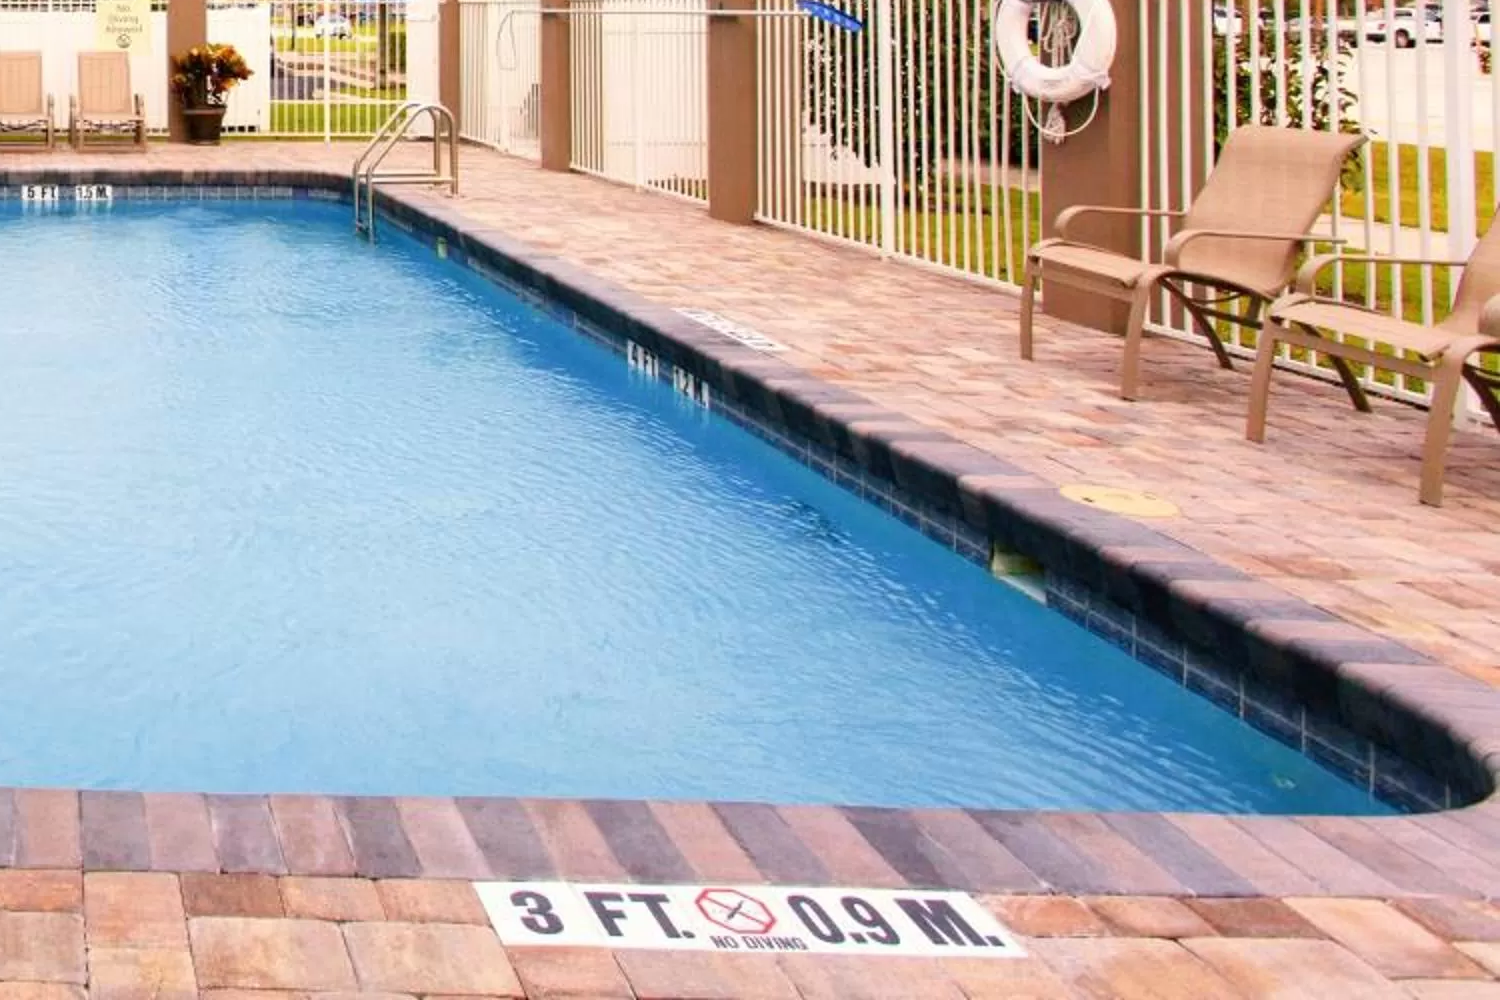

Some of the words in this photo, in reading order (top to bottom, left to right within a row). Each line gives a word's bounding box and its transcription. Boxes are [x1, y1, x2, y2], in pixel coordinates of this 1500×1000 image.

[27, 184, 35, 199] 5
[41, 184, 57, 199] FT
[510, 890, 565, 936] 3
[582, 891, 695, 940] FT.
[787, 894, 901, 945] 0.9
[894, 898, 1007, 949] M.
[711, 935, 739, 949] NO
[743, 935, 810, 951] DIVING
